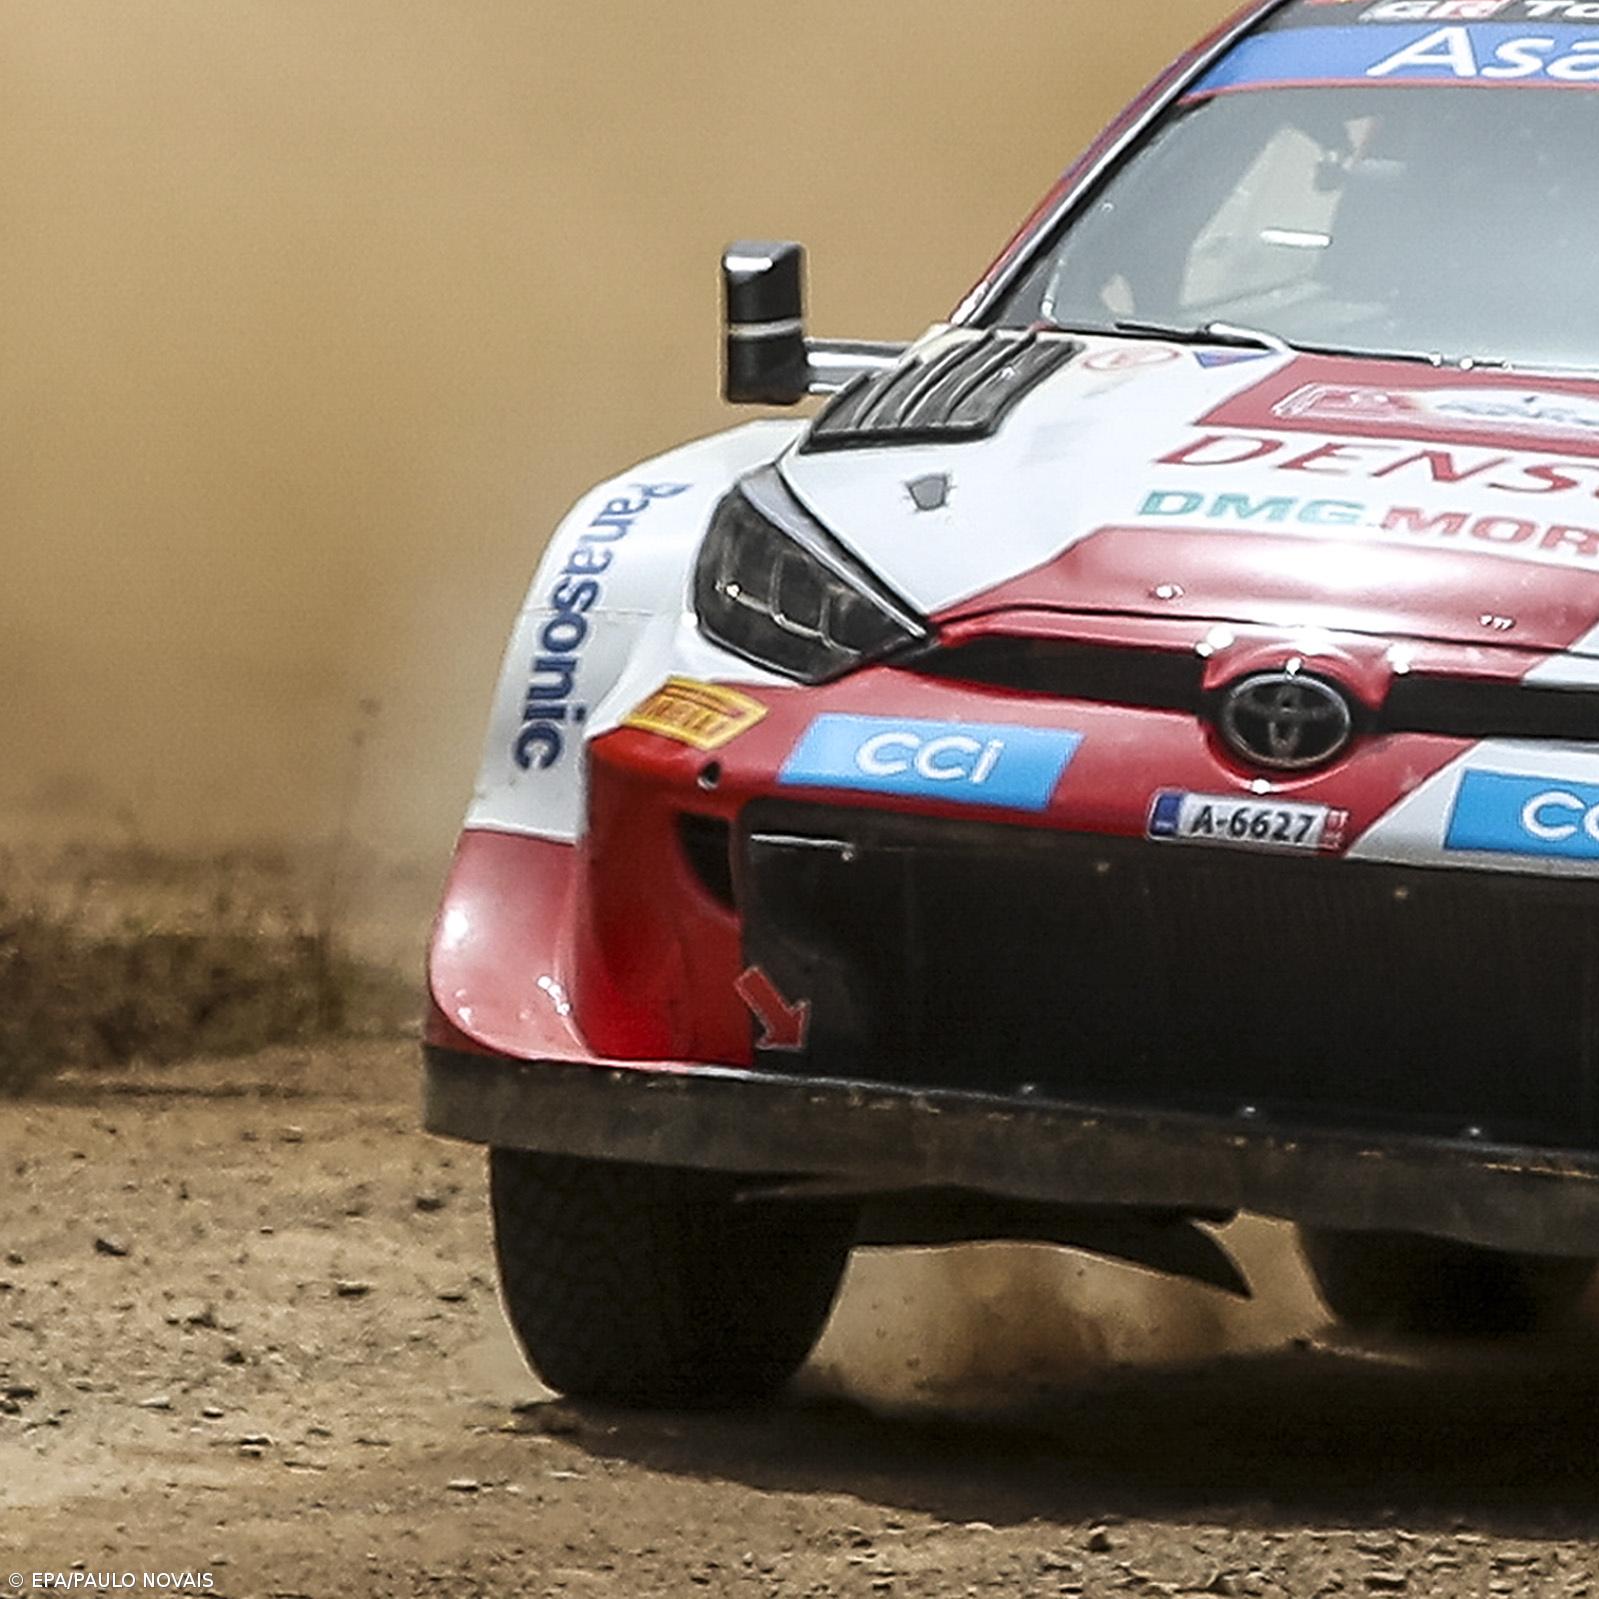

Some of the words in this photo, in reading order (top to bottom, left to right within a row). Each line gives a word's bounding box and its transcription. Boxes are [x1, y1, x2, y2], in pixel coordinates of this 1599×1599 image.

[1138, 489, 1366, 525] DMG
[514, 482, 694, 771] Panasonic
[1191, 805, 1316, 843] A-6627
